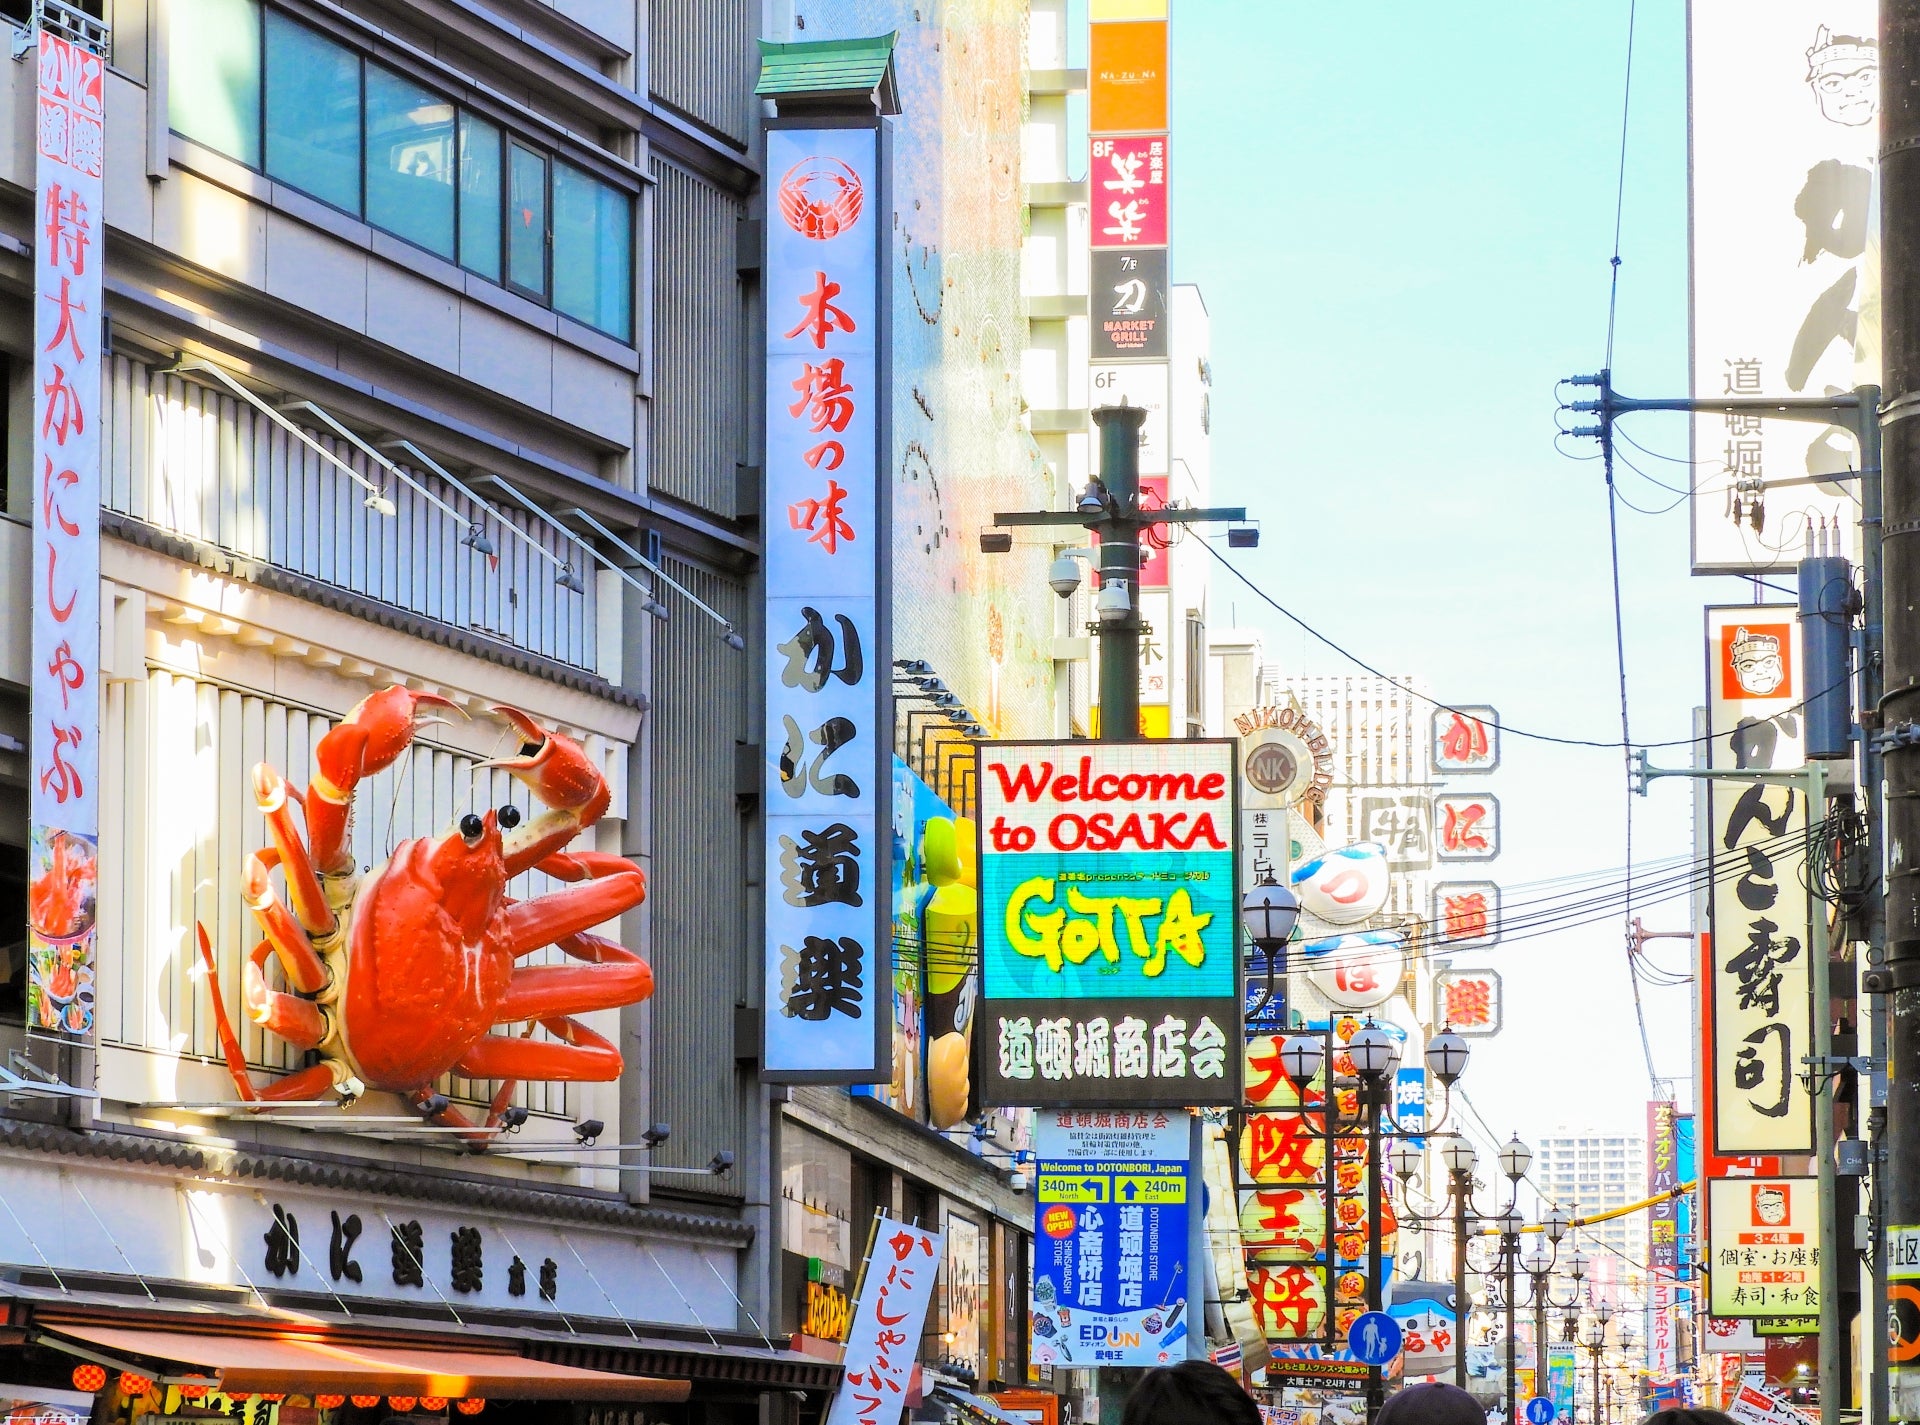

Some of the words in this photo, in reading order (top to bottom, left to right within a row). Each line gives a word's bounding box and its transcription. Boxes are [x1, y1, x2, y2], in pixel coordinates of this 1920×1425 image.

[1093, 141, 1114, 157] 8F
[1121, 256, 1138, 272] 7F
[1104, 320, 1155, 332] MARKET
[1111, 331, 1148, 343] GRILL
[1095, 373, 1117, 389] 6F
[784, 271, 856, 555] 本場の味
[42, 181, 91, 804] 特大かにしゃぶ
[988, 756, 1225, 803] Welcome
[1256, 757, 1286, 781] NK
[989, 816, 1036, 852] to
[1047, 812, 1228, 851] OSAKA
[998, 1015, 1226, 1080] 道頓堀商店会
[1398, 1081, 1425, 1133] 焼肉
[1056, 1111, 1170, 1129] 道頓堀商店会
[1041, 1163, 1082, 1172] Welcome
[1085, 1164, 1095, 1172] to
[1155, 1164, 1183, 1175] Japan
[1846, 1157, 1863, 1165] CH4
[1042, 1179, 1078, 1192] 340m
[1145, 1180, 1181, 1193] 240m
[1243, 1036, 1328, 1338] 大阪王将
[1046, 1219, 1073, 1233] OPEN!
[1048, 1210, 1069, 1222] NEW
[1149, 1207, 1159, 1254] DOTONBORI
[1054, 1240, 1063, 1266] STORE
[1063, 1240, 1073, 1294] SHINSAIBASHI
[1149, 1254, 1159, 1281] STORE
[1080, 1325, 1141, 1348] EDION
